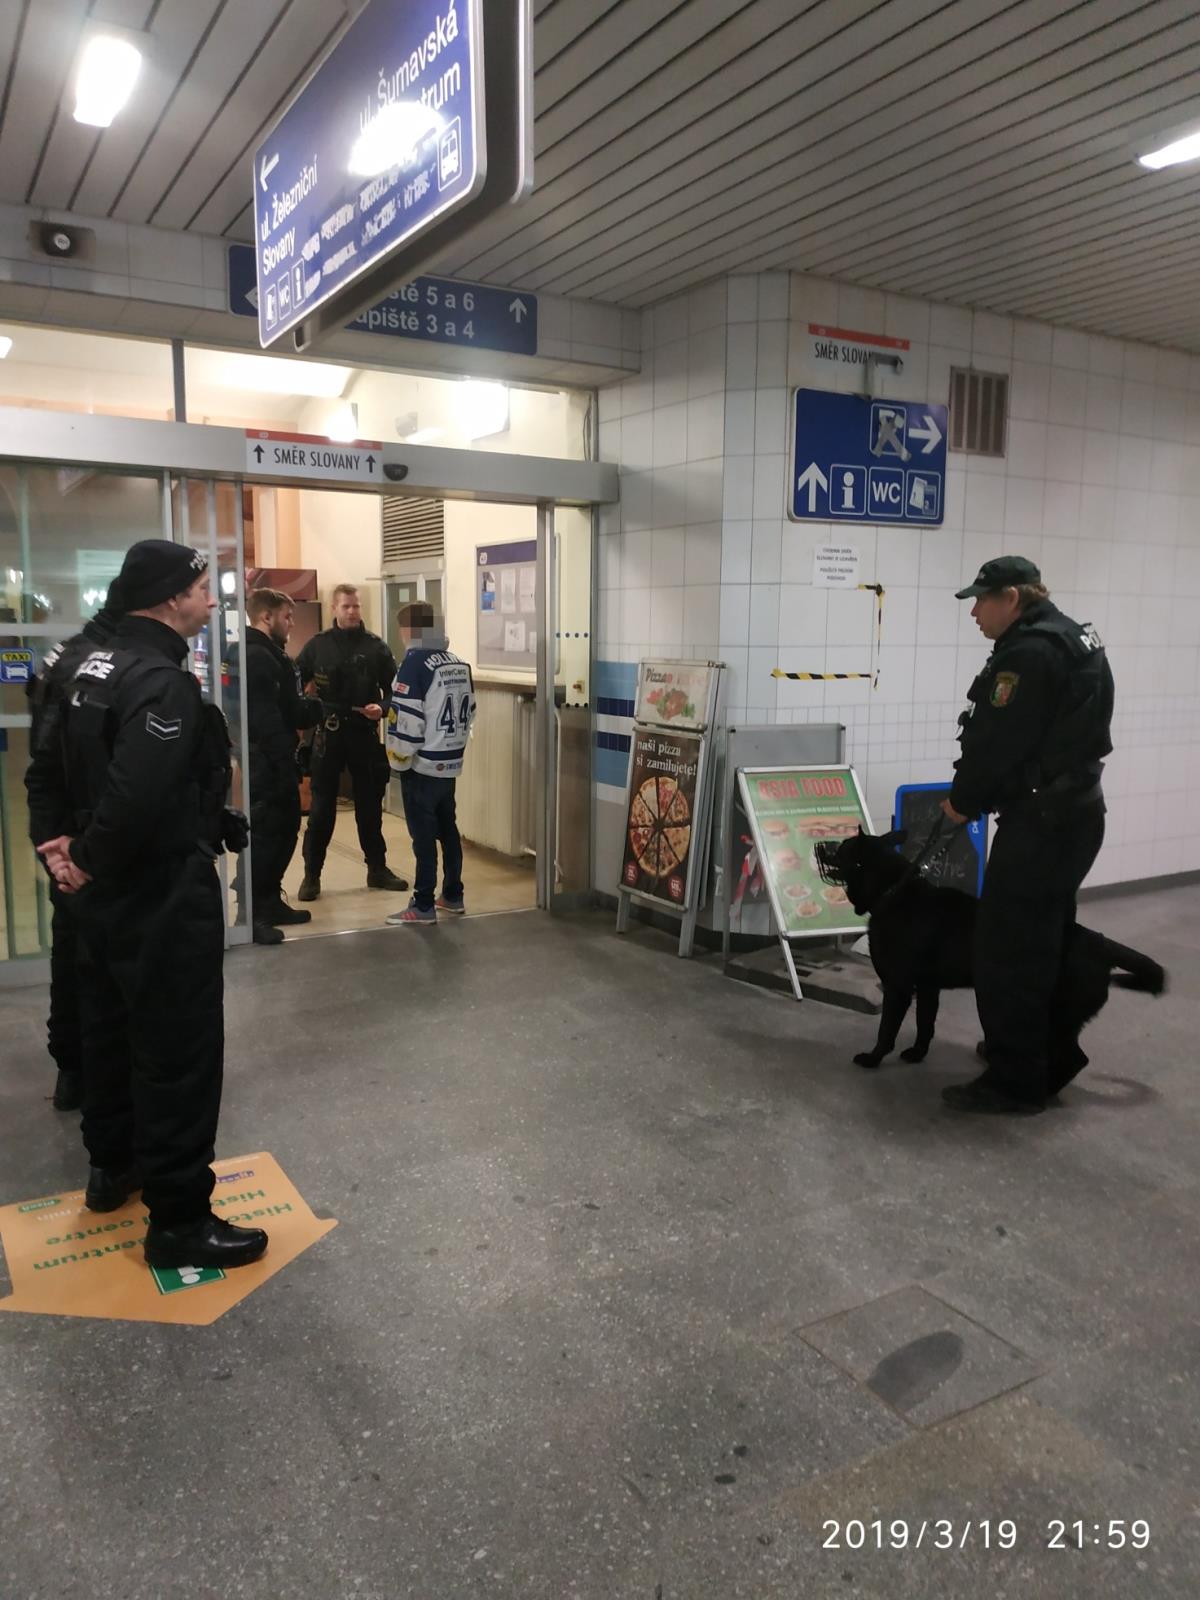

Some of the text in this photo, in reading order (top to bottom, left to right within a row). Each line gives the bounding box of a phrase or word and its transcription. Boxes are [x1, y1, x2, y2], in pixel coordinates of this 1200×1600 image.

[378, 0, 459, 109] Šumavská
[261, 211, 271, 242] ul.
[272, 153, 318, 231] Železniční
[263, 226, 296, 276] Slovany
[426, 286, 438, 305] 5
[445, 293, 456, 309] a
[463, 292, 475, 312] 6
[426, 314, 438, 334] 3
[445, 321, 456, 337] a
[463, 320, 475, 339] 4
[814, 341, 839, 361] SMĚR
[274, 446, 360, 470] SMĚR SLOVANY
[872, 481, 901, 503] WC
[2, 652, 31, 662] TAXI
[436, 693, 472, 738] 44
[637, 739, 656, 752] naši
[636, 754, 697, 776] si zamilujete!
[758, 777, 848, 799] ASIA FOOD
[46, 1220, 133, 1245] centre
